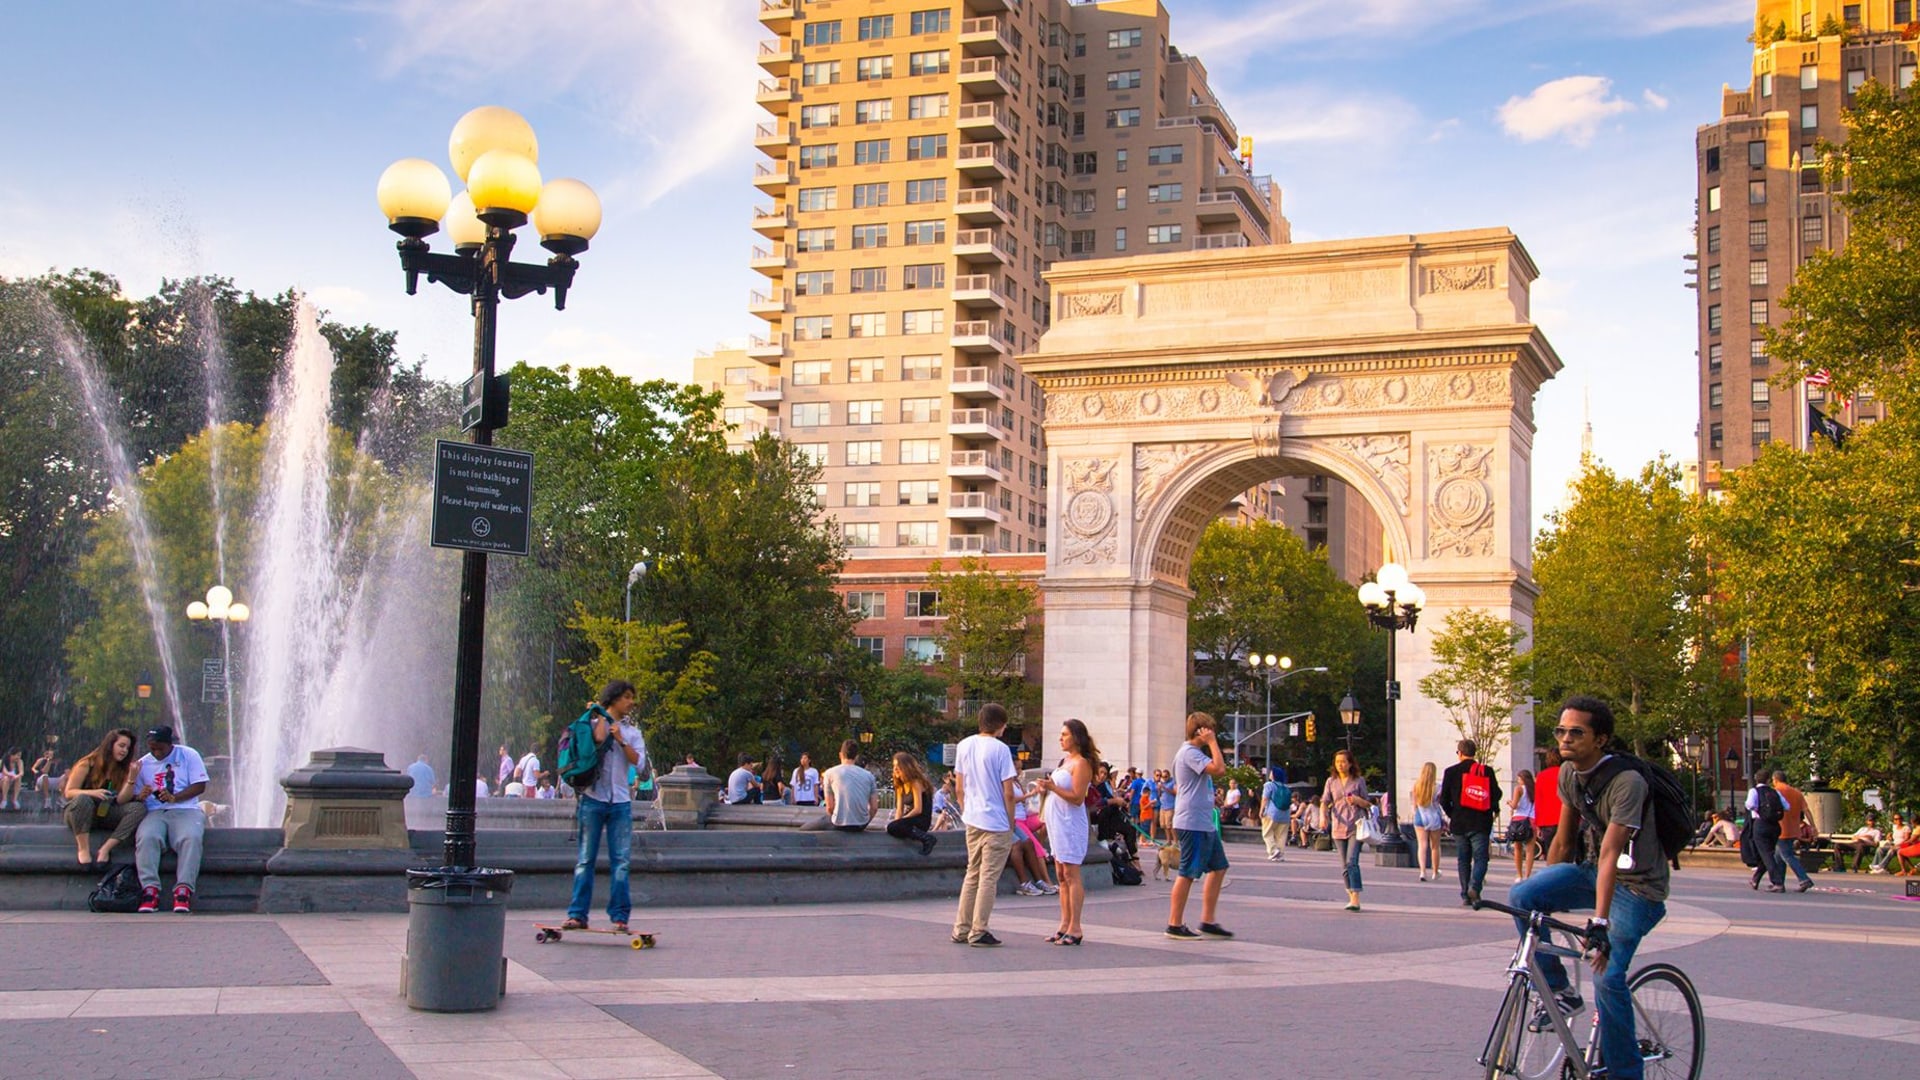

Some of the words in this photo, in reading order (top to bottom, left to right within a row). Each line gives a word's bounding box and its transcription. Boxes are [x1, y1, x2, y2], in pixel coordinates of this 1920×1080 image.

[442, 450, 460, 460] This
[462, 453, 492, 466] display
[494, 457, 529, 470] fountain
[449, 467, 456, 476] is
[457, 469, 470, 478] not
[471, 470, 482, 479] for
[483, 472, 511, 485] bathing
[442, 495, 462, 506] Please
[463, 497, 480, 510] keep
[480, 500, 491, 509] off
[492, 503, 509, 511] water
[510, 503, 524, 514] jets.
